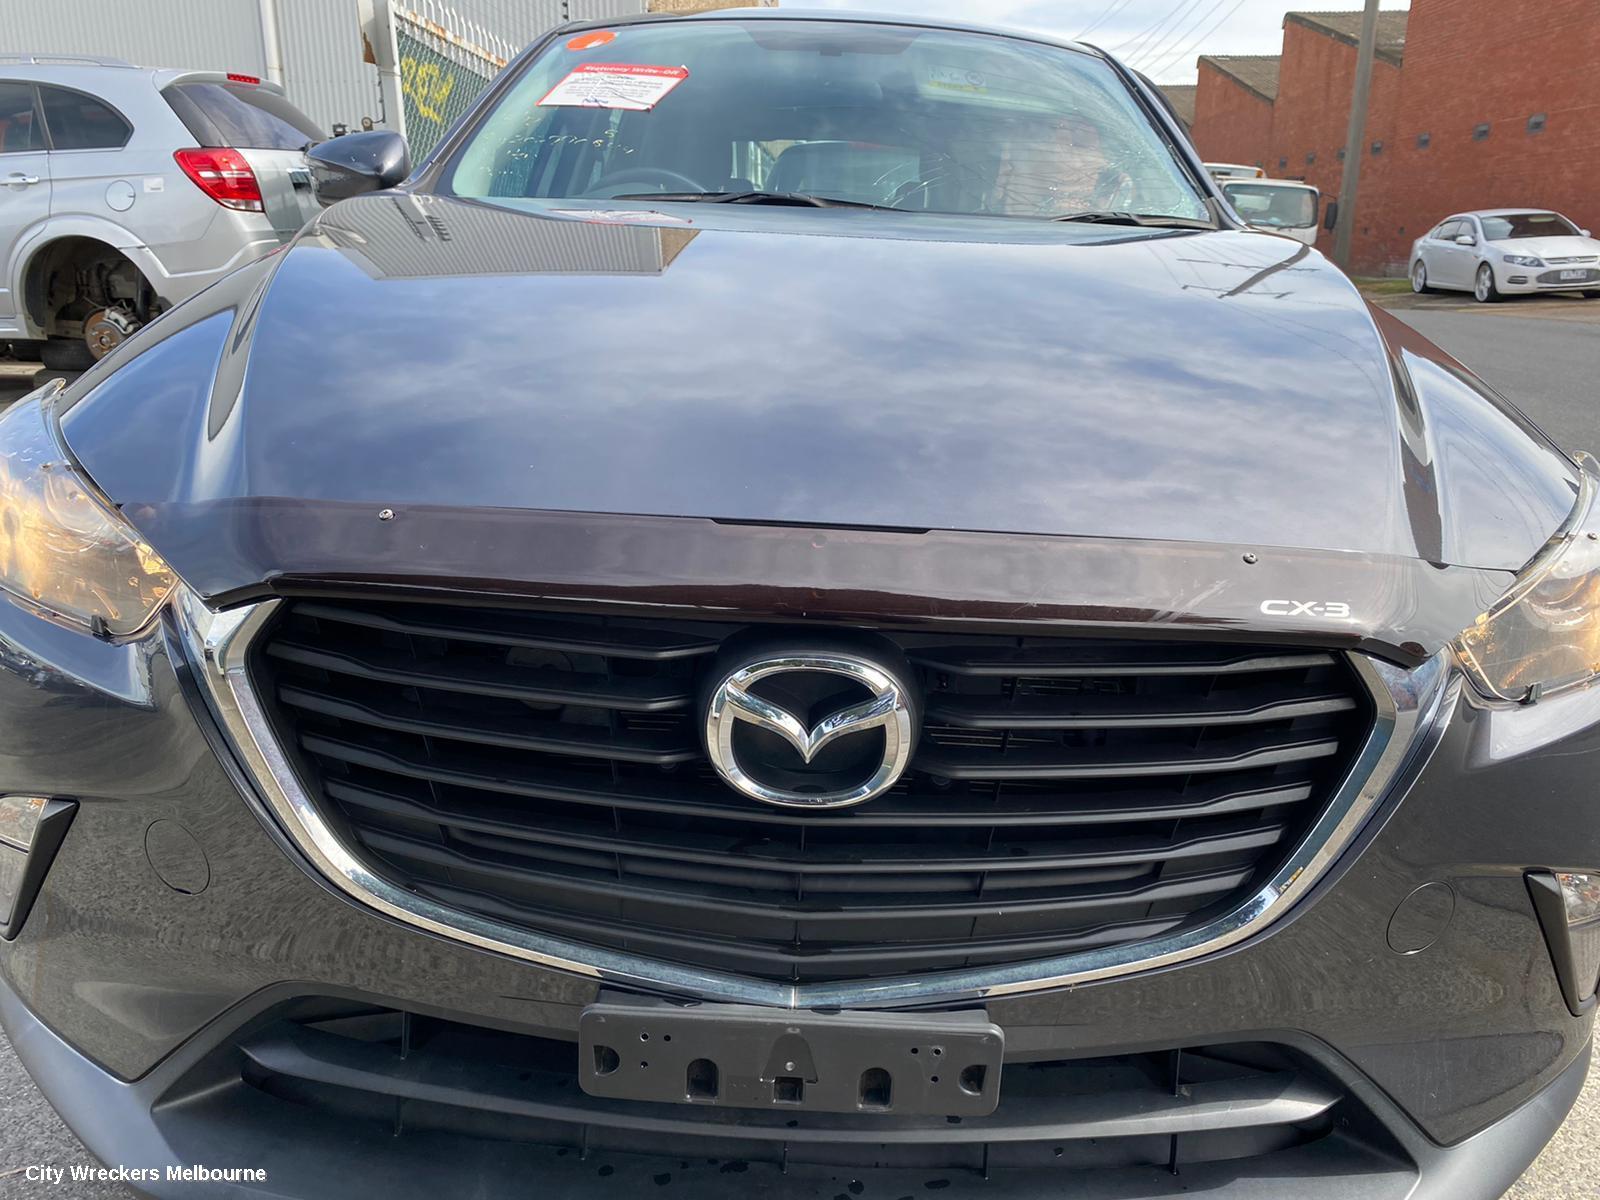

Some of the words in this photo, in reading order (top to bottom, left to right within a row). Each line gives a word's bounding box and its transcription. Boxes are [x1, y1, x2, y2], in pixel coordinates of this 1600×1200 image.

[583, 65, 631, 73] Statutory
[632, 67, 680, 75] Write-Off
[1260, 599, 1350, 618] CX-3
